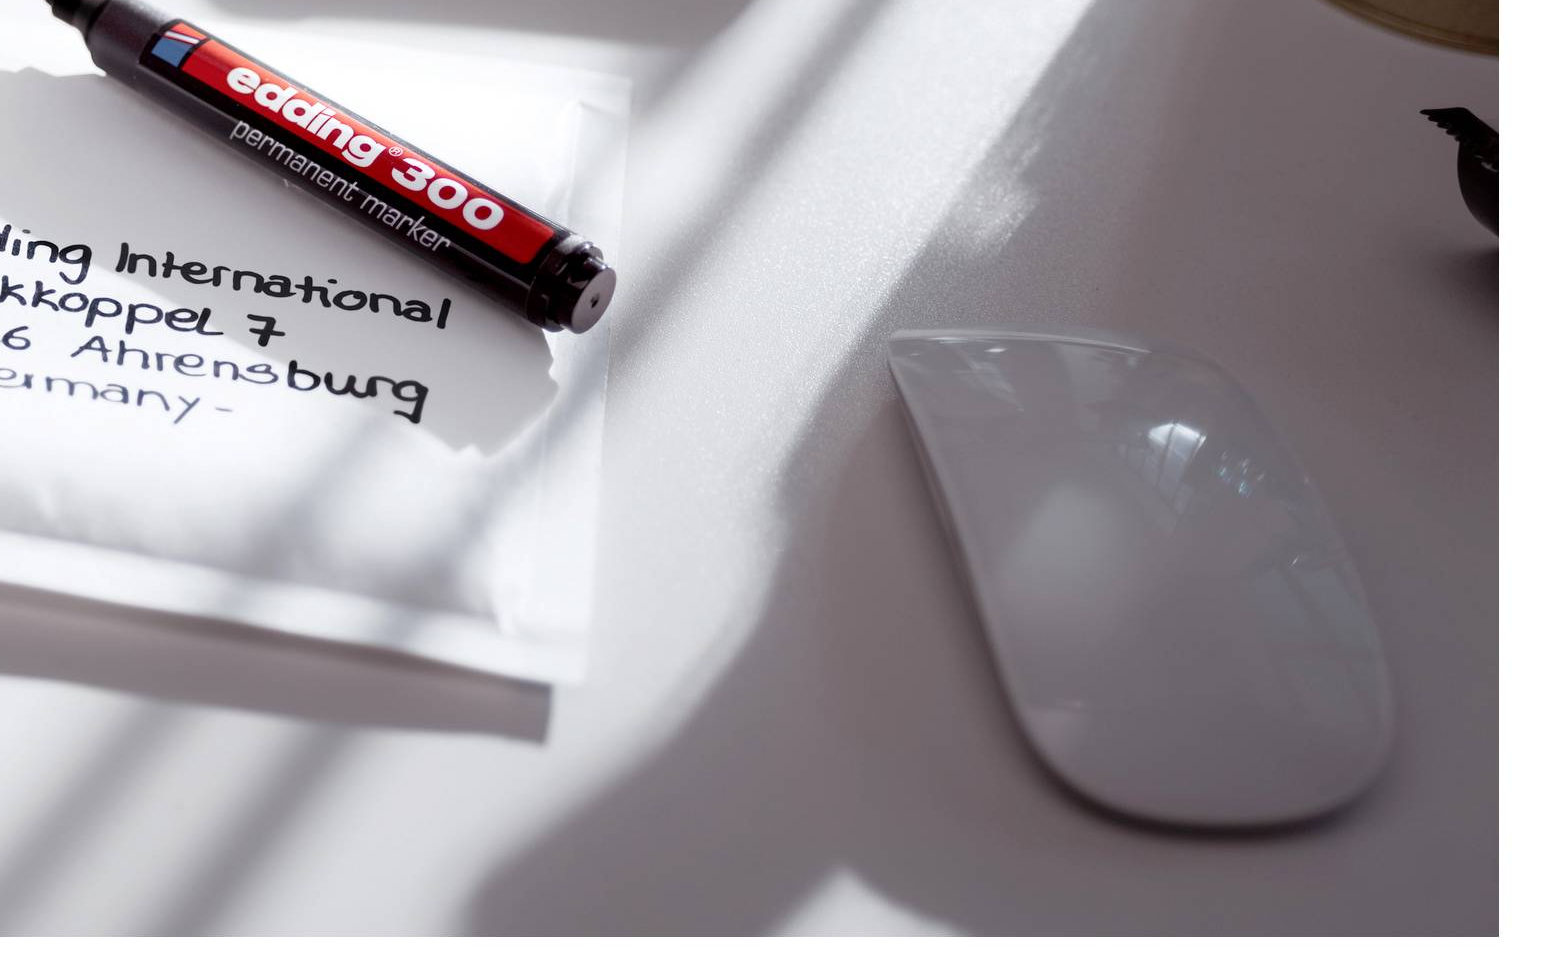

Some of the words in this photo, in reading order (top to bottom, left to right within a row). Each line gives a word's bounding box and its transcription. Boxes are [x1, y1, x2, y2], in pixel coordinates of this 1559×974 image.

[229, 119, 360, 202] permanent
[365, 193, 451, 253] marker
[390, 156, 505, 231] 300
[113, 240, 453, 331] International
[246, 313, 287, 348] 7
[69, 334, 430, 425] Ahrensburg
